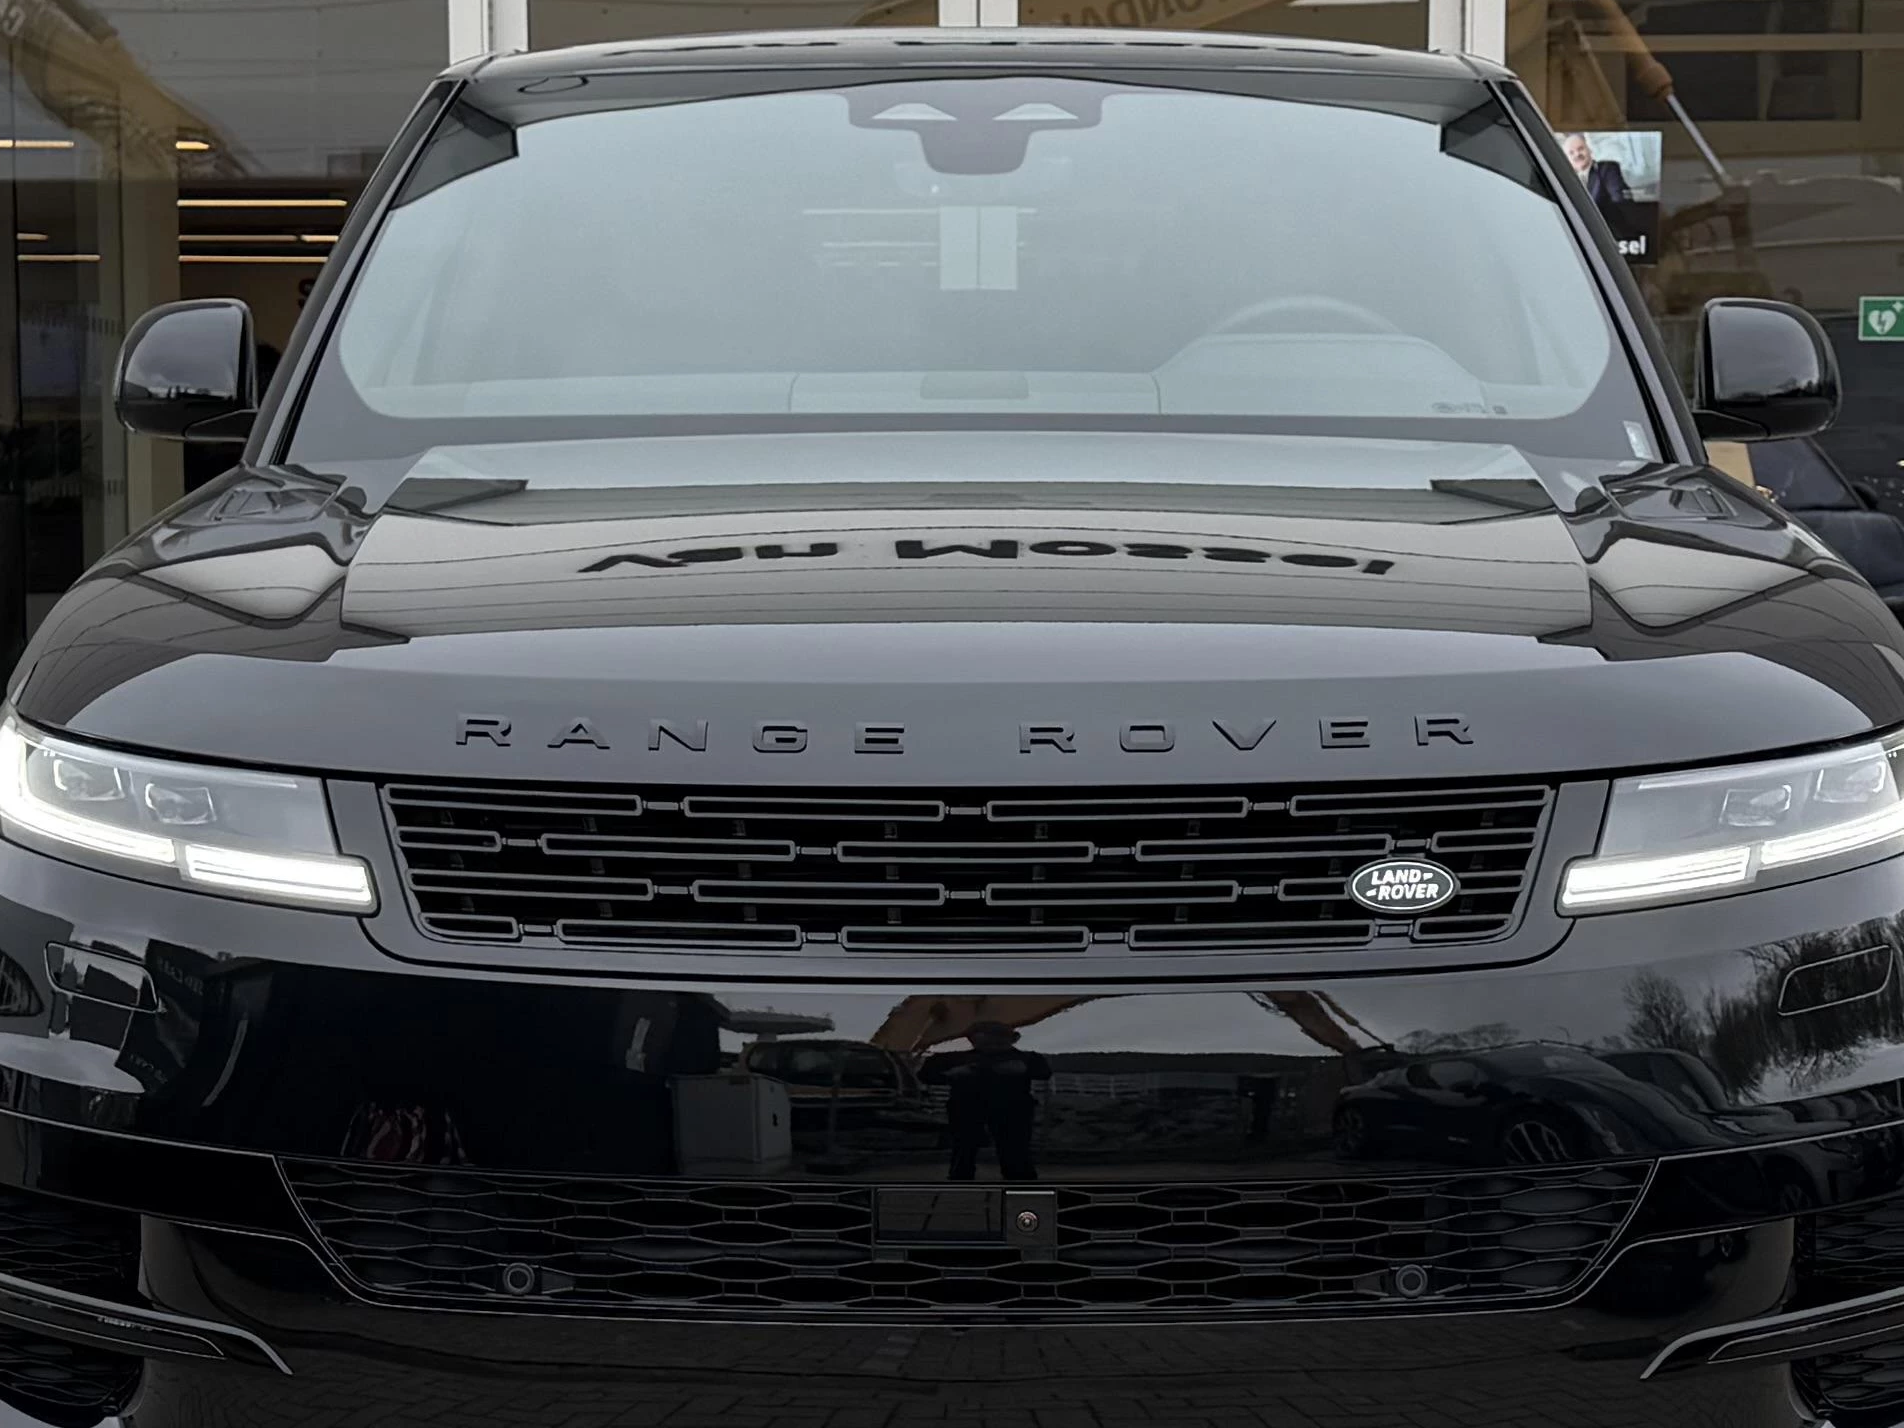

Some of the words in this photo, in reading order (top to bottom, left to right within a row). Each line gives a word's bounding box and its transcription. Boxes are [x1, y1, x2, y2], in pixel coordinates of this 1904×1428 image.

[1618, 235, 1646, 254] sel
[454, 711, 907, 756] RANGE
[1018, 711, 1475, 755] ROVER
[1371, 869, 1421, 885] LAND
[1377, 883, 1439, 900] ROVER
